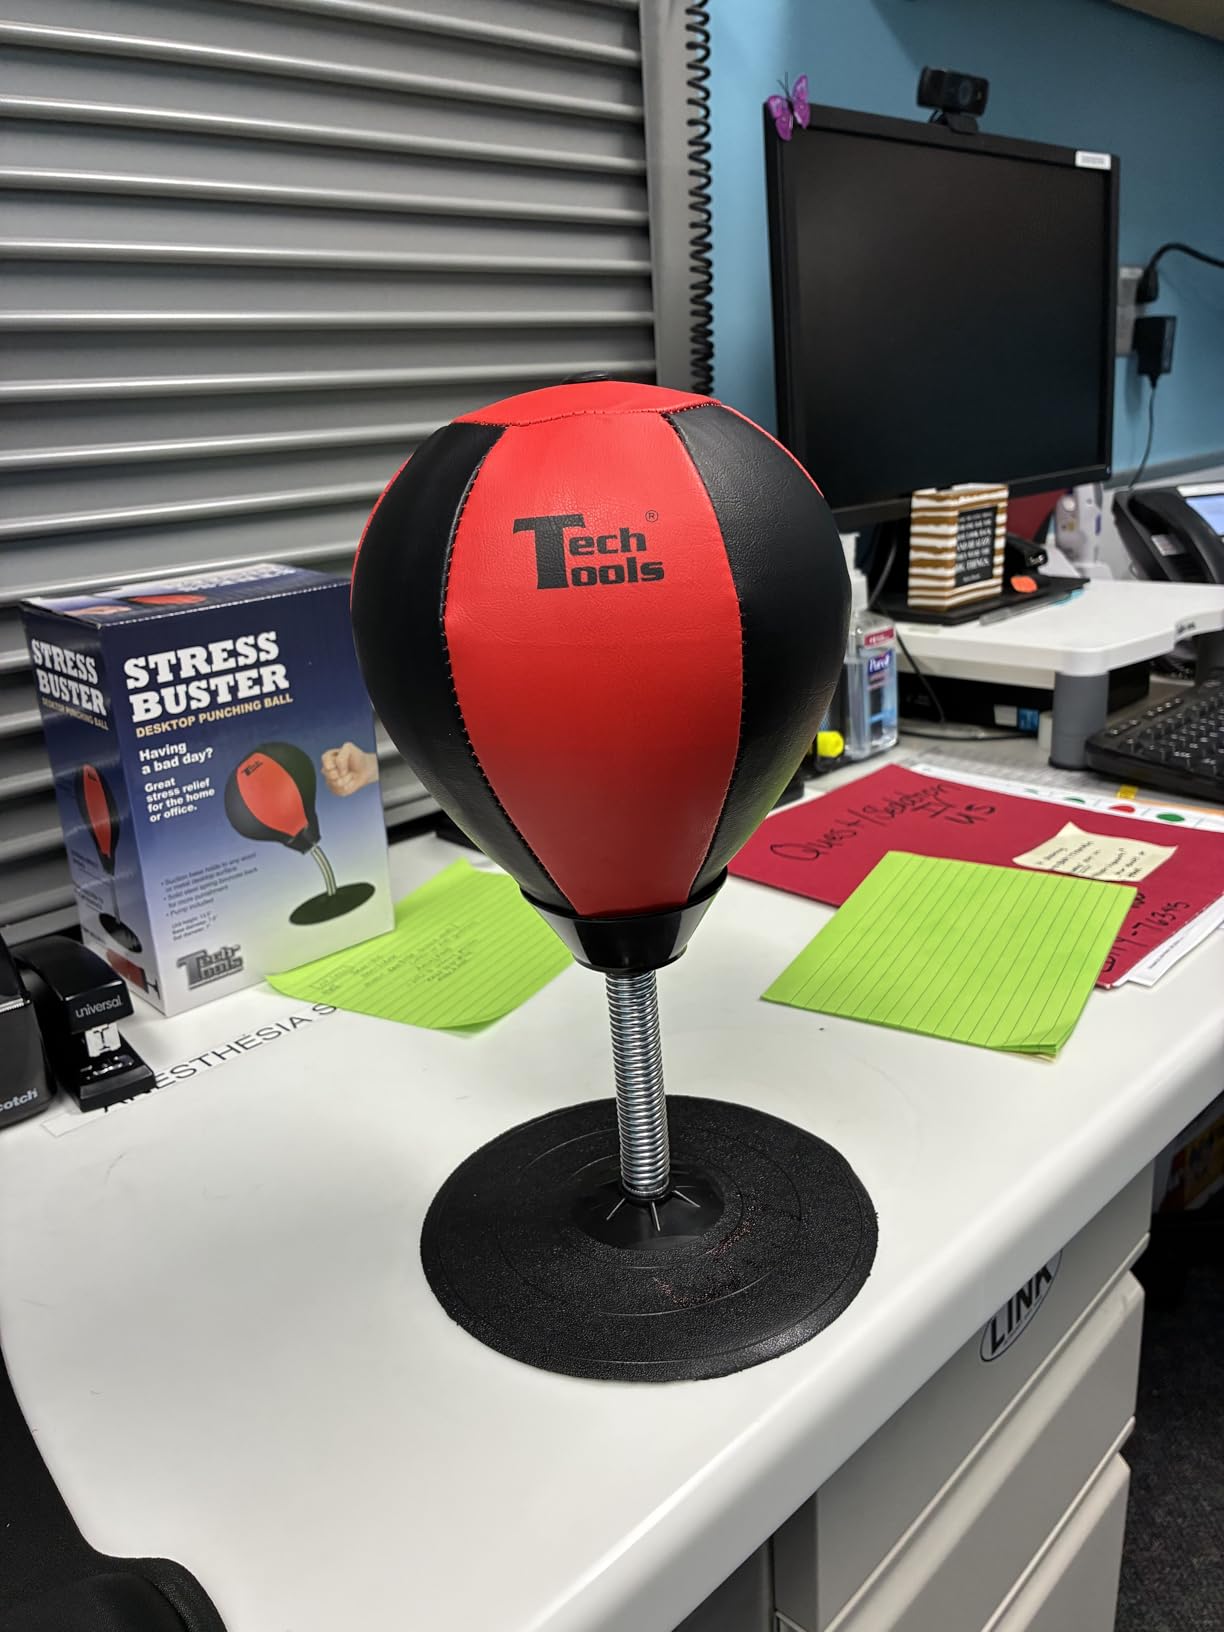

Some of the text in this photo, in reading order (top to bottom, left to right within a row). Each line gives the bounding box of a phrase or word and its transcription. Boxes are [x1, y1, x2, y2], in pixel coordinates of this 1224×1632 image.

[32, 638, 98, 685] STRESS
[124, 631, 279, 690] STRESS
[36, 669, 107, 716] BUSTER
[129, 663, 290, 723] BUSTER
[136, 693, 293, 738] DESKTOP PUNCHING BALL
[139, 742, 187, 762] Having
[141, 747, 213, 775] a bad day?
[144, 777, 176, 793] Great
[146, 777, 210, 803] stress relief
[147, 788, 215, 813] for the home
[149, 804, 198, 823] or office.
[75, 995, 122, 1018] universal
